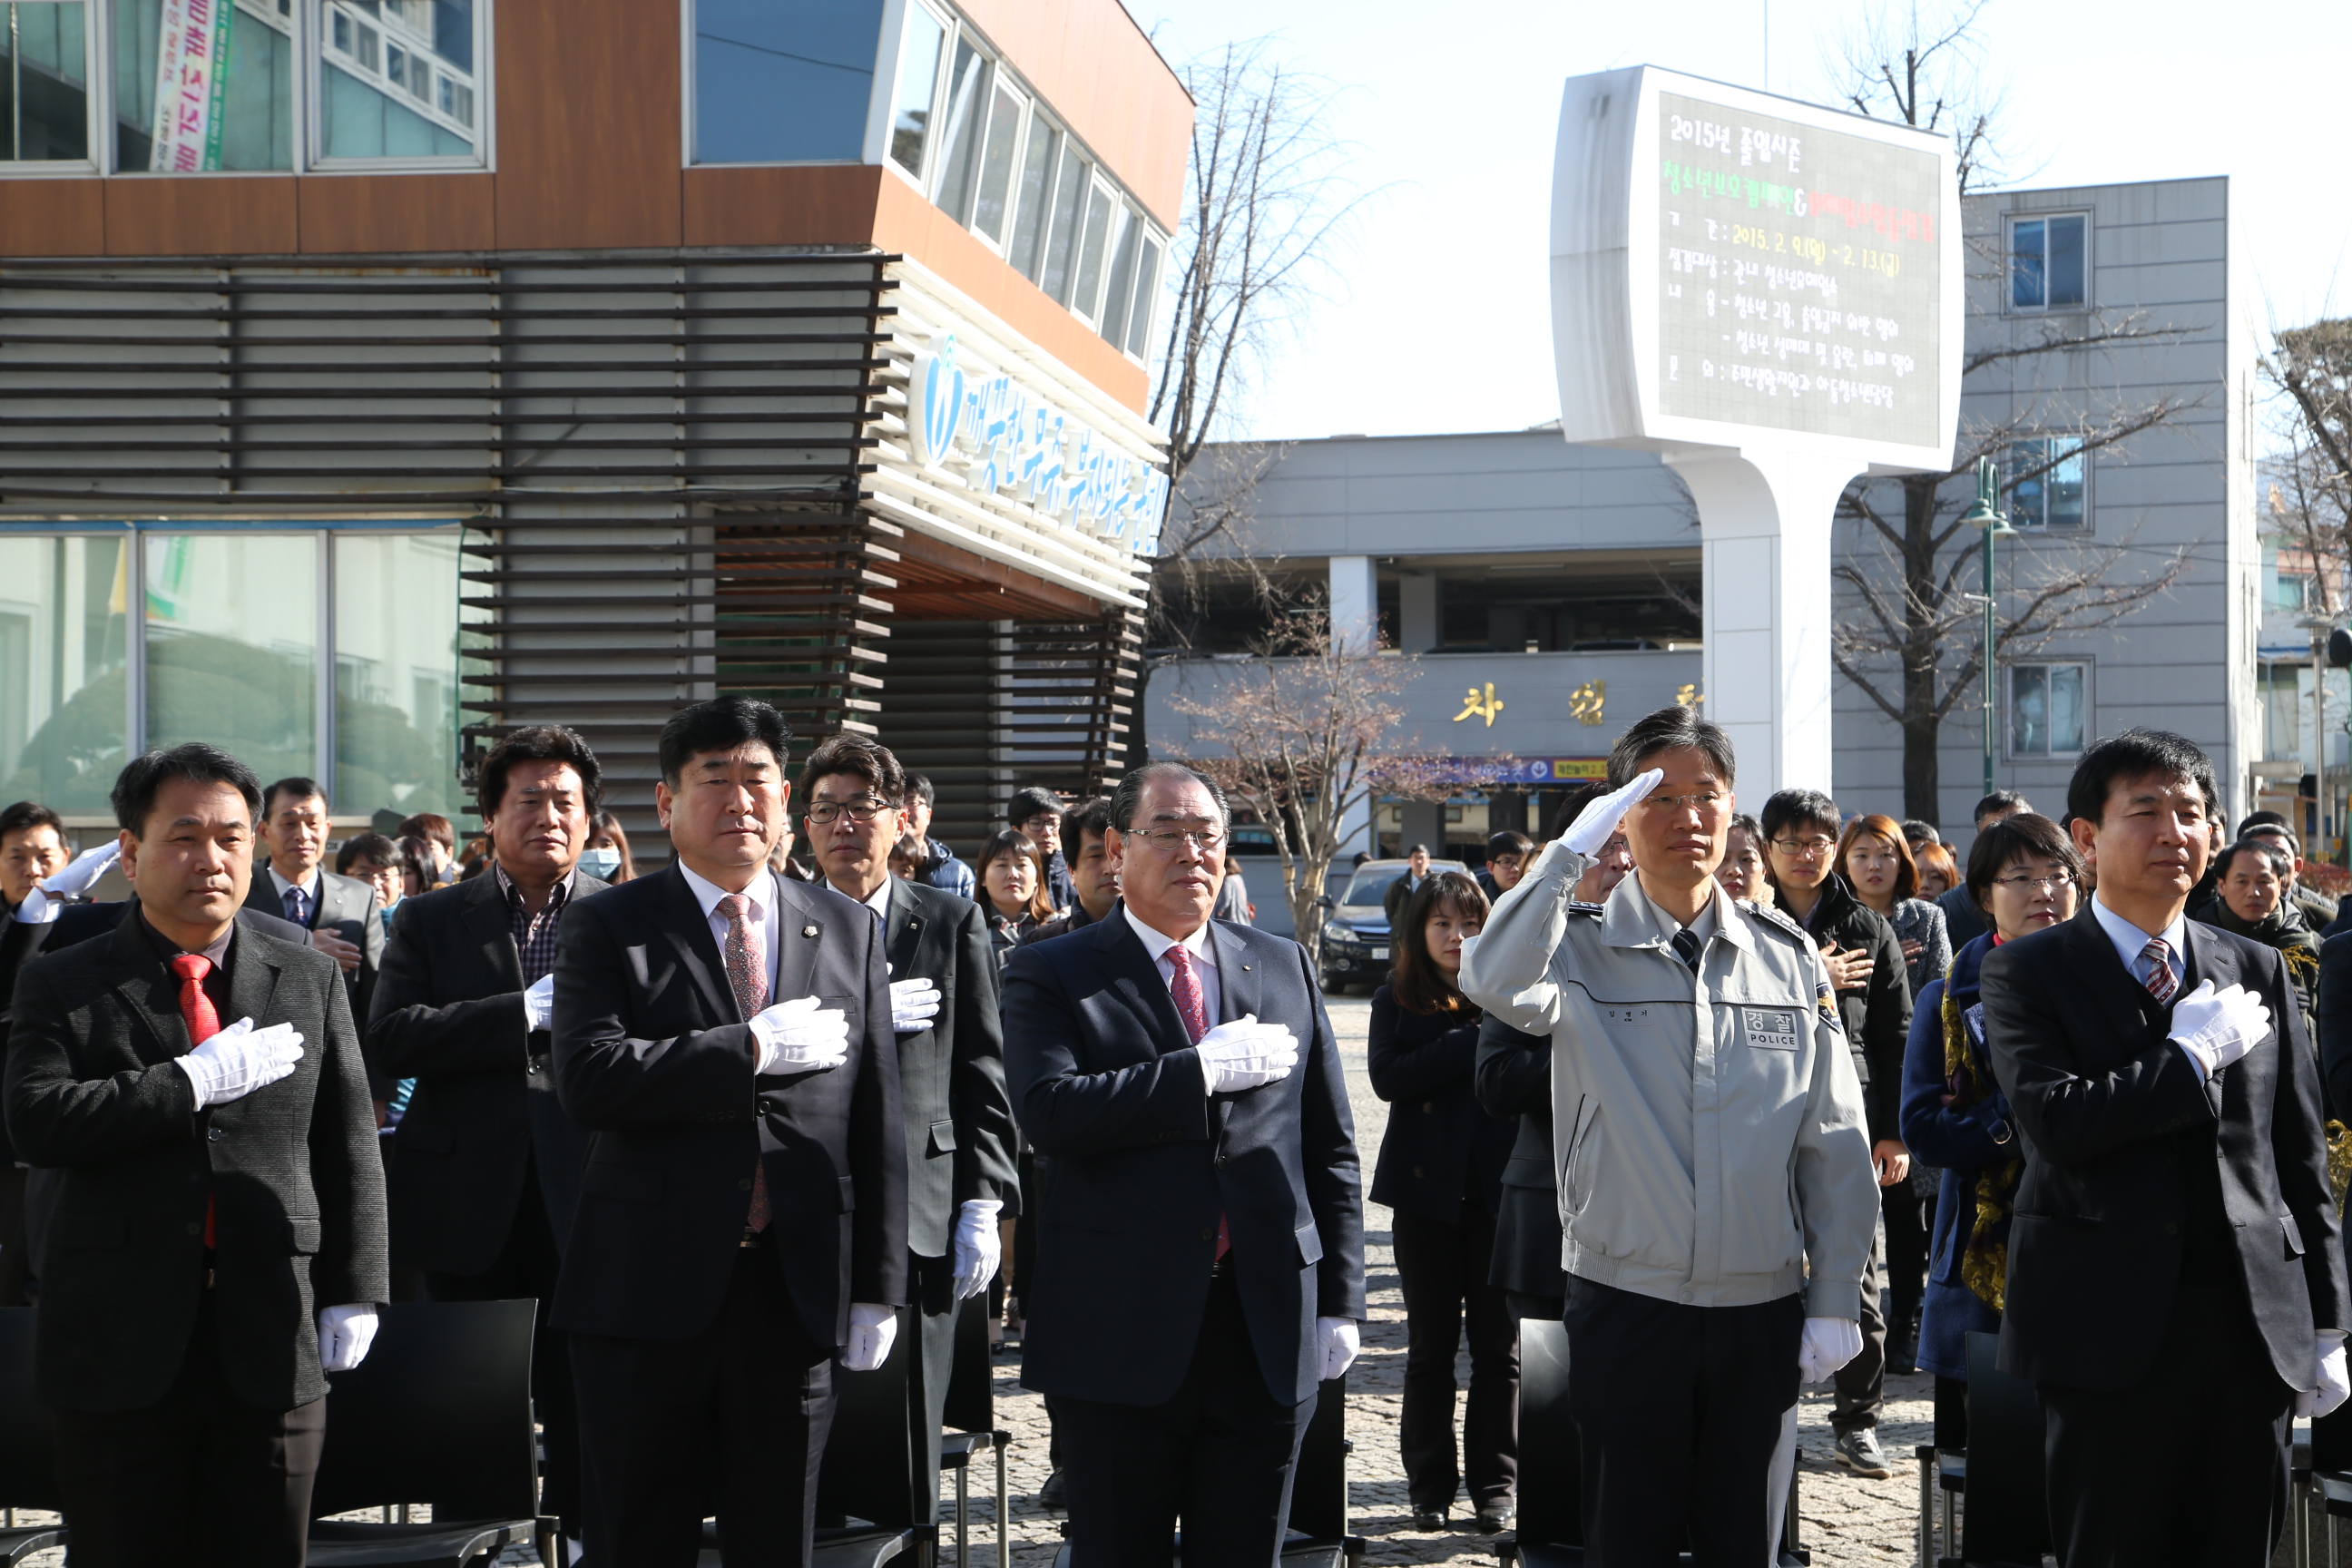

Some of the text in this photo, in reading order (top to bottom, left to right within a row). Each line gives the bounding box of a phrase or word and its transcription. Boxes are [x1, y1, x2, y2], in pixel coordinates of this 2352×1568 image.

[1670, 113, 1800, 173] 2015년 졸업시즌
[1732, 223, 1769, 250] 2015.
[1668, 246, 1717, 273] 점검대상
[1733, 258, 1758, 288] 관내
[1764, 262, 1838, 299] 청소년유해업소
[1734, 293, 1768, 322] 청소년
[1802, 304, 1841, 338] 출입금지
[1847, 311, 1870, 336] 위반
[1876, 316, 1898, 343] 행위
[1736, 328, 1769, 358] 청소년
[1775, 336, 1809, 363] 성매매
[1815, 341, 1828, 366] 및
[1891, 352, 1914, 379] 행위
[1731, 363, 1811, 400] 주민생활지원과
[1816, 375, 1893, 411] 아동청소년담당
[1750, 1034, 1795, 1045] POLICE
